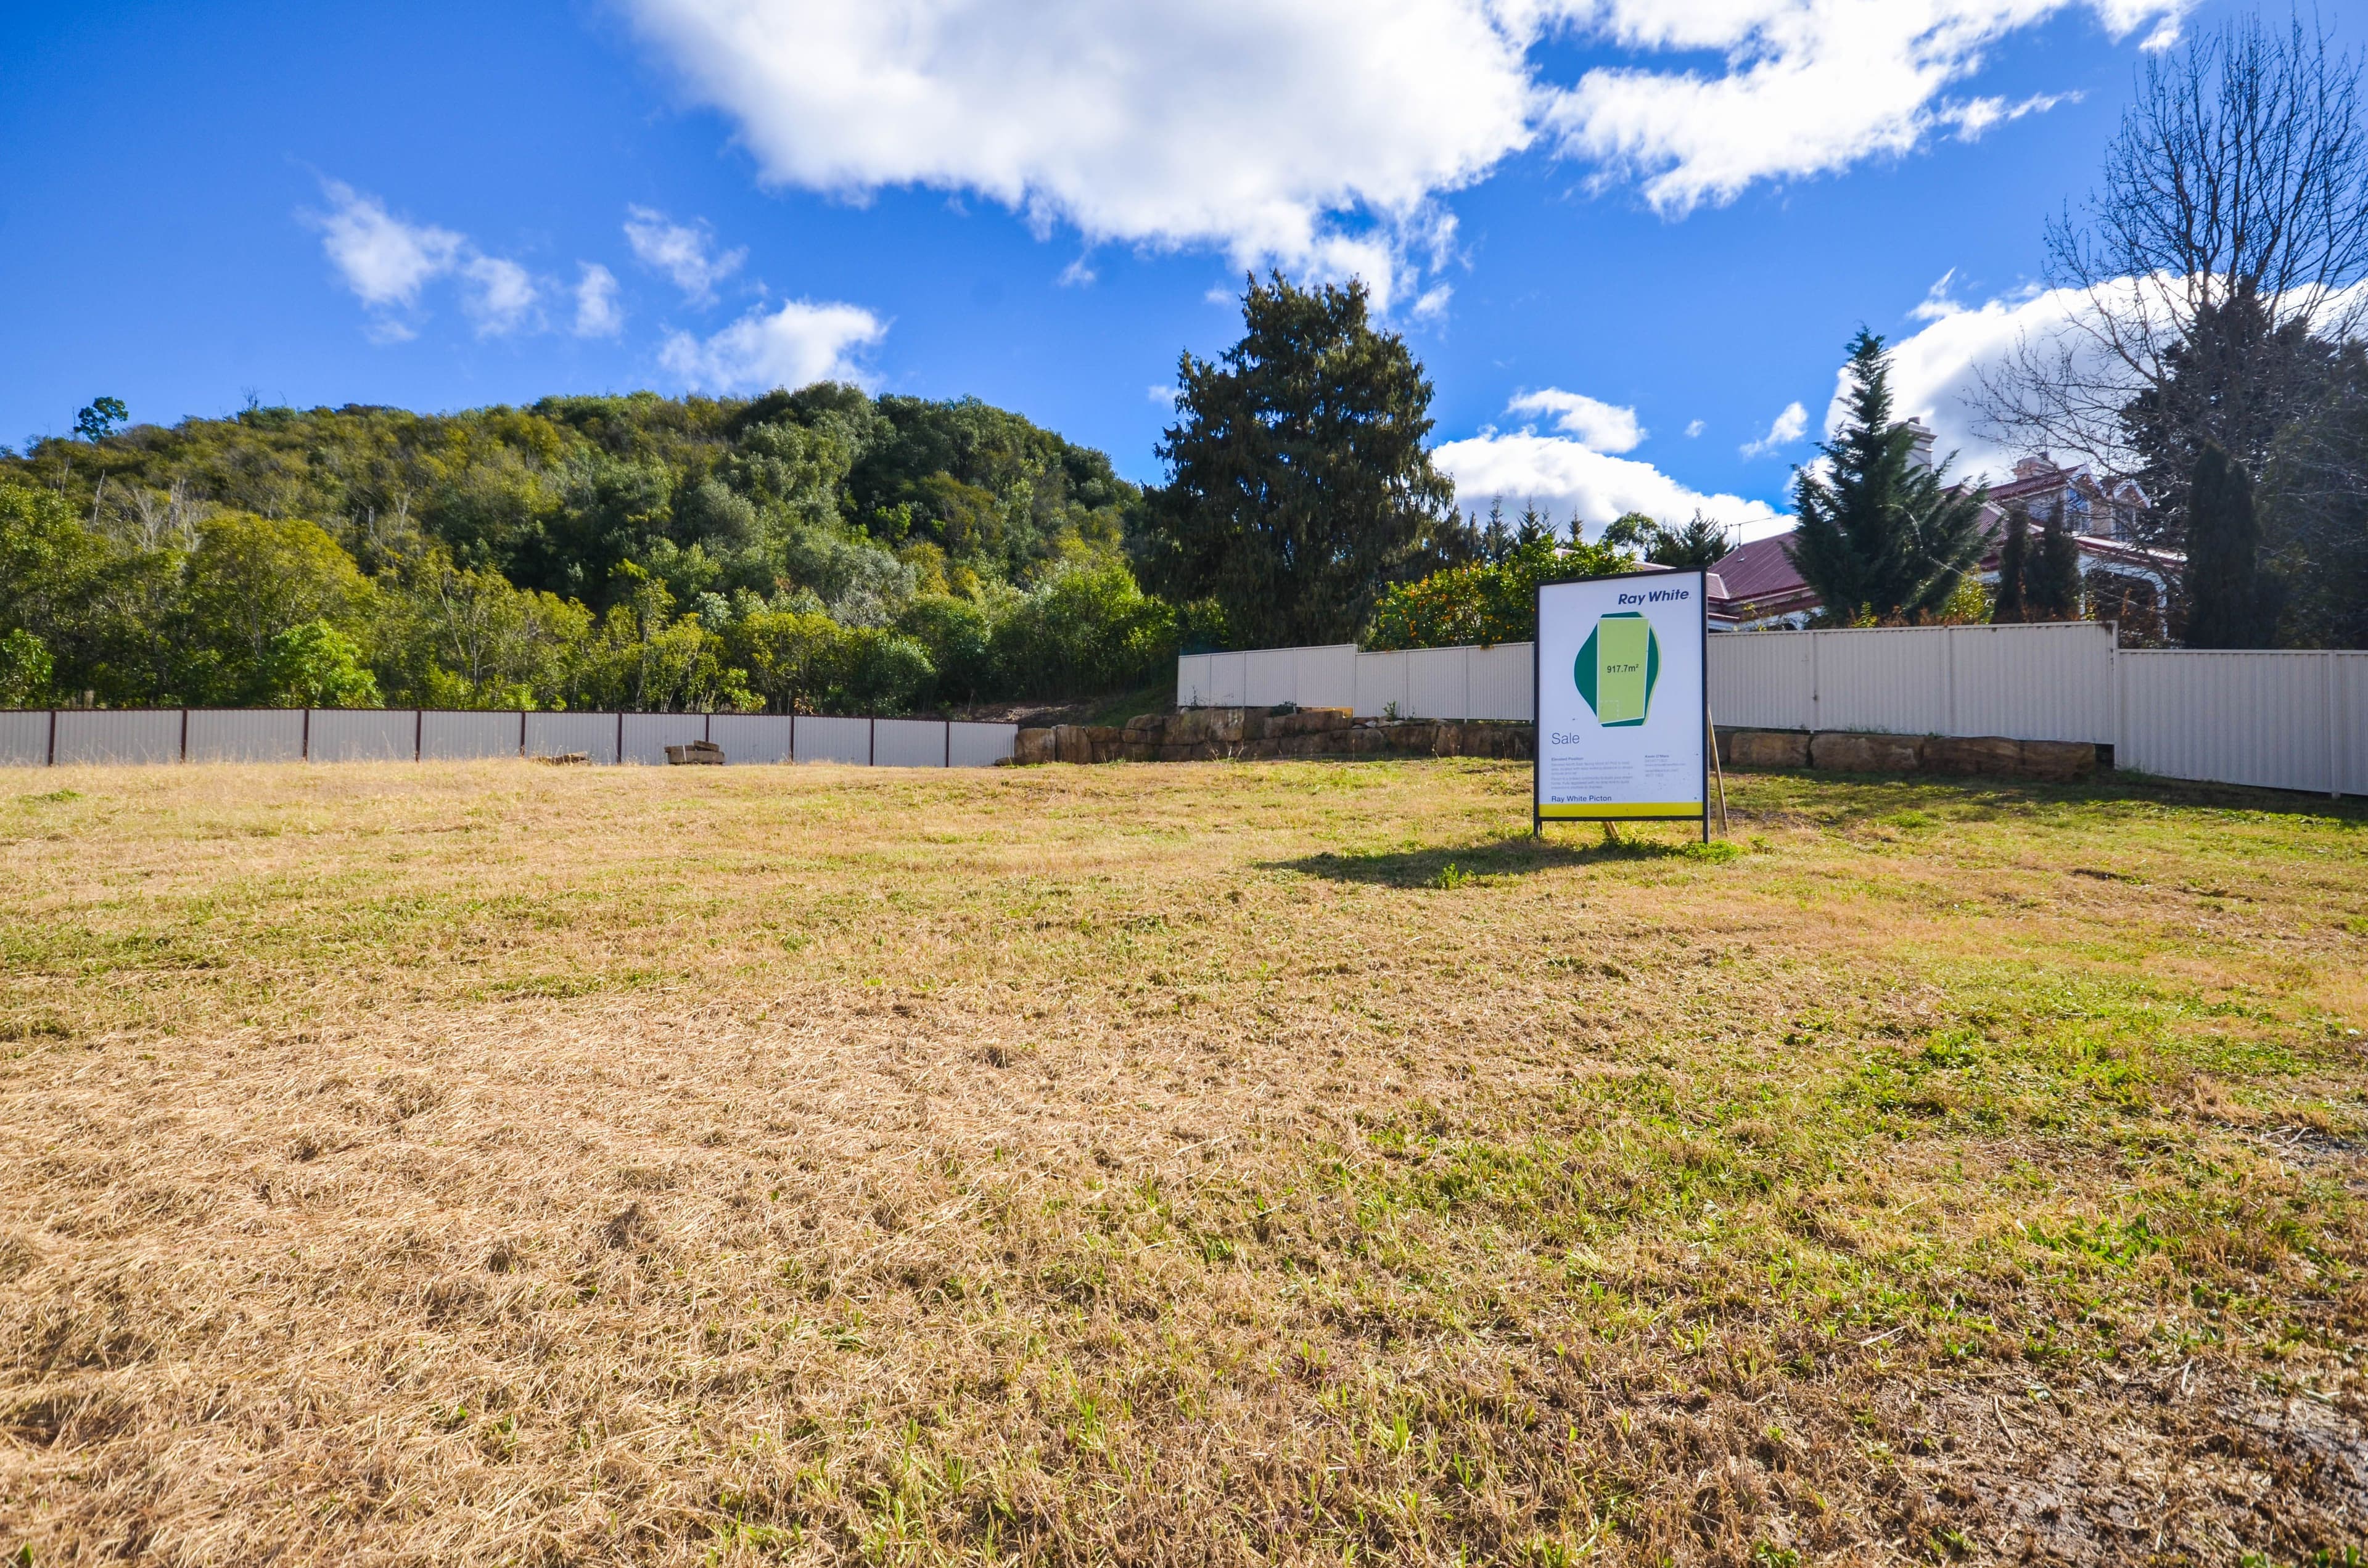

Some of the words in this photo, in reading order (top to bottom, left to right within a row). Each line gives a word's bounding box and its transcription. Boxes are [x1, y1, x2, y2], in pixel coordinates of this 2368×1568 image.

[1618, 594, 1646, 605] Ray
[1649, 589, 1690, 602] White
[1552, 733, 1580, 744] Sale
